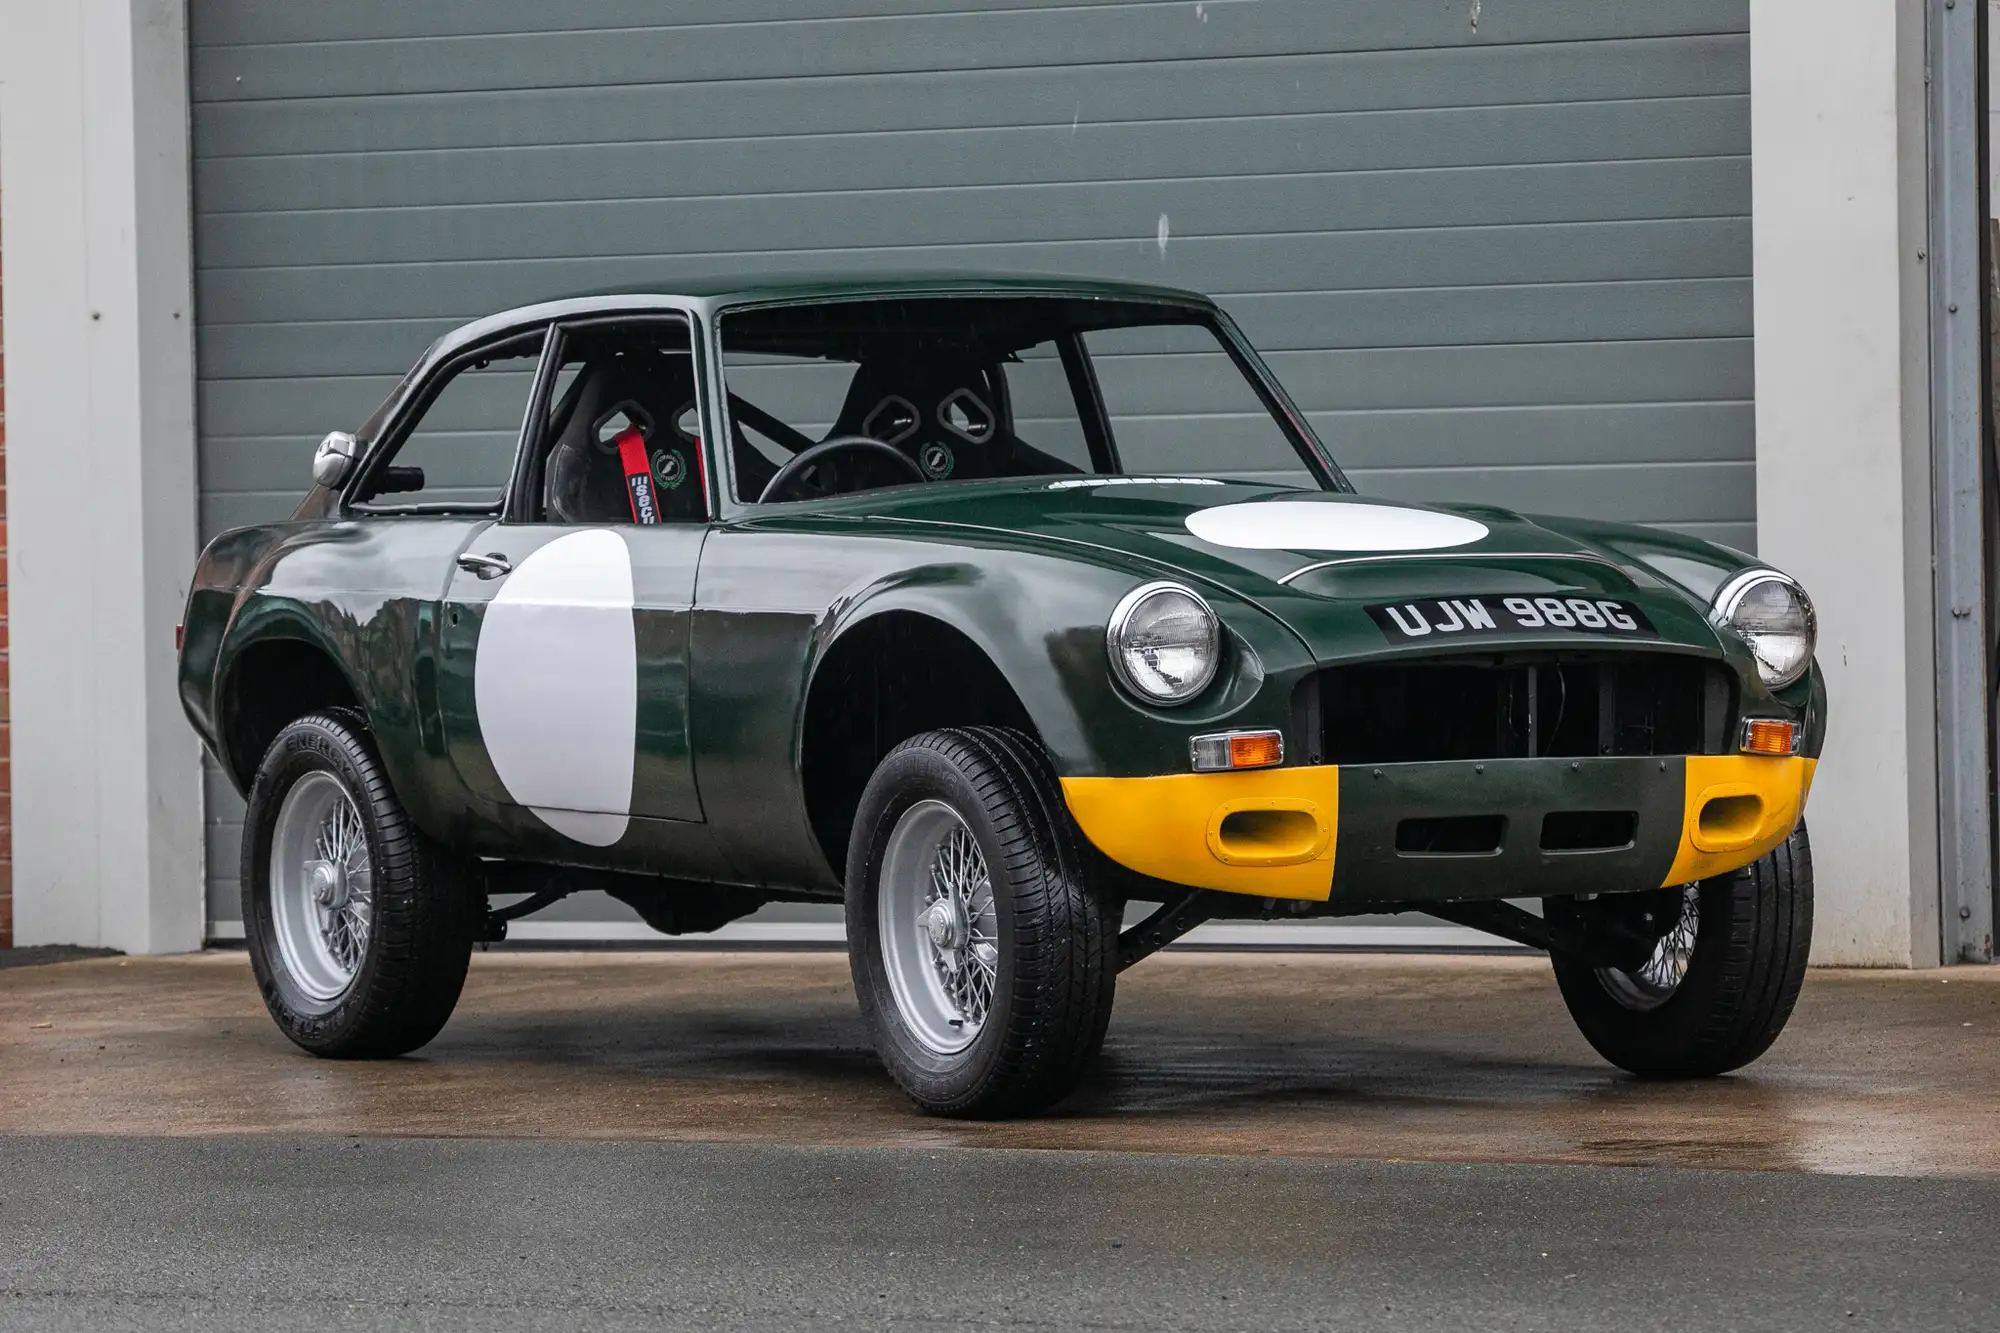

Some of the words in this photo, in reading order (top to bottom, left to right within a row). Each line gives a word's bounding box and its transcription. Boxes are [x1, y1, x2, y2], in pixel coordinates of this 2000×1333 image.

[1385, 598, 1497, 637] UJW
[1502, 597, 1638, 631] 988G
[286, 732, 351, 773] ENERGY
